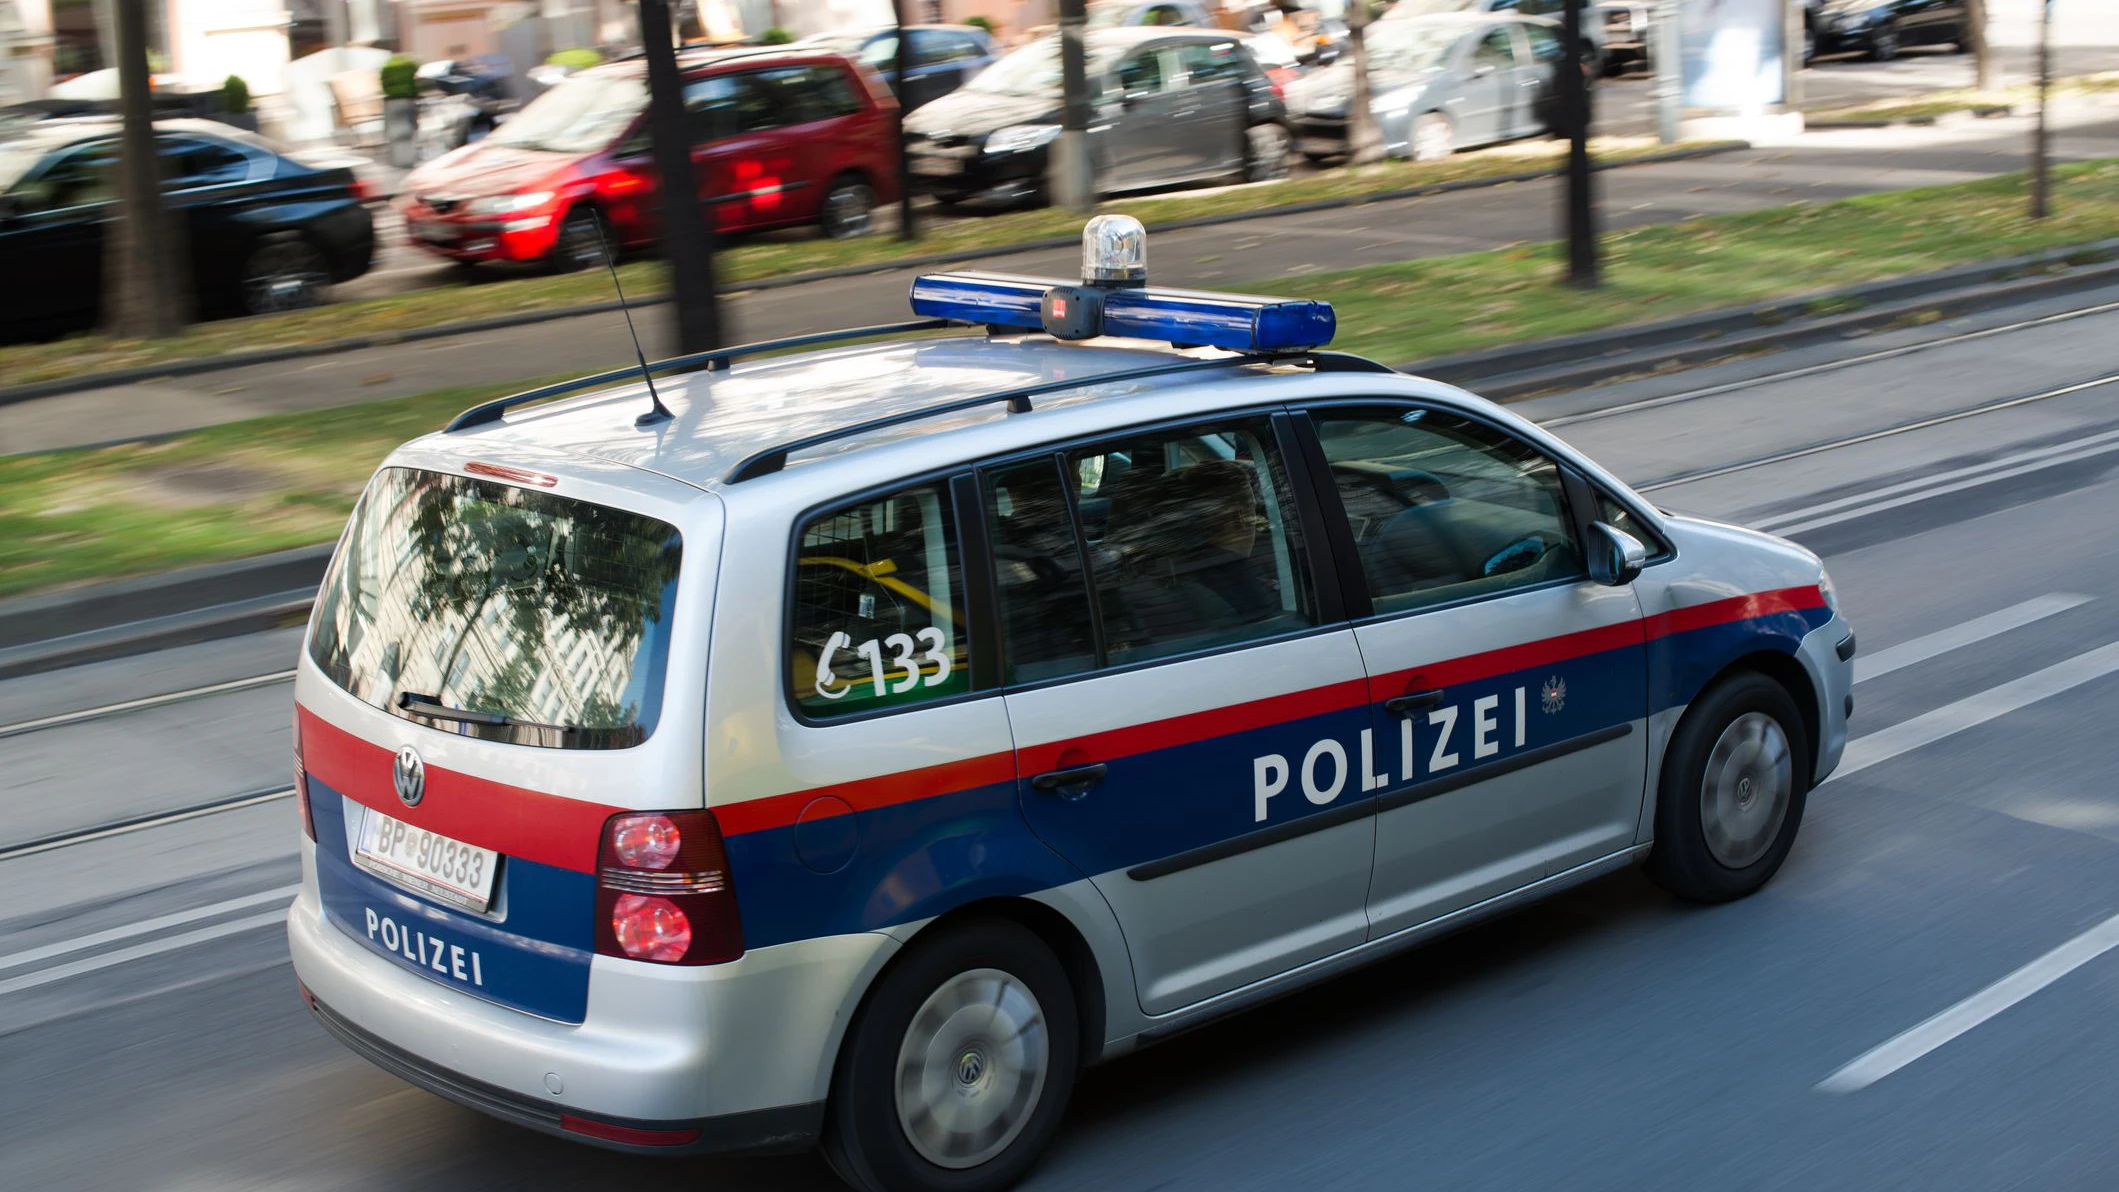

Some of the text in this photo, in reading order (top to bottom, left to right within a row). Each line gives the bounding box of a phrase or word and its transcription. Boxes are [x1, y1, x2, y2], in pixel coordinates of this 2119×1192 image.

[858, 627, 951, 697] 133
[1254, 687, 1526, 822] POLIZEI
[378, 816, 484, 889] BP 90333
[366, 907, 482, 985] POLIZEI
